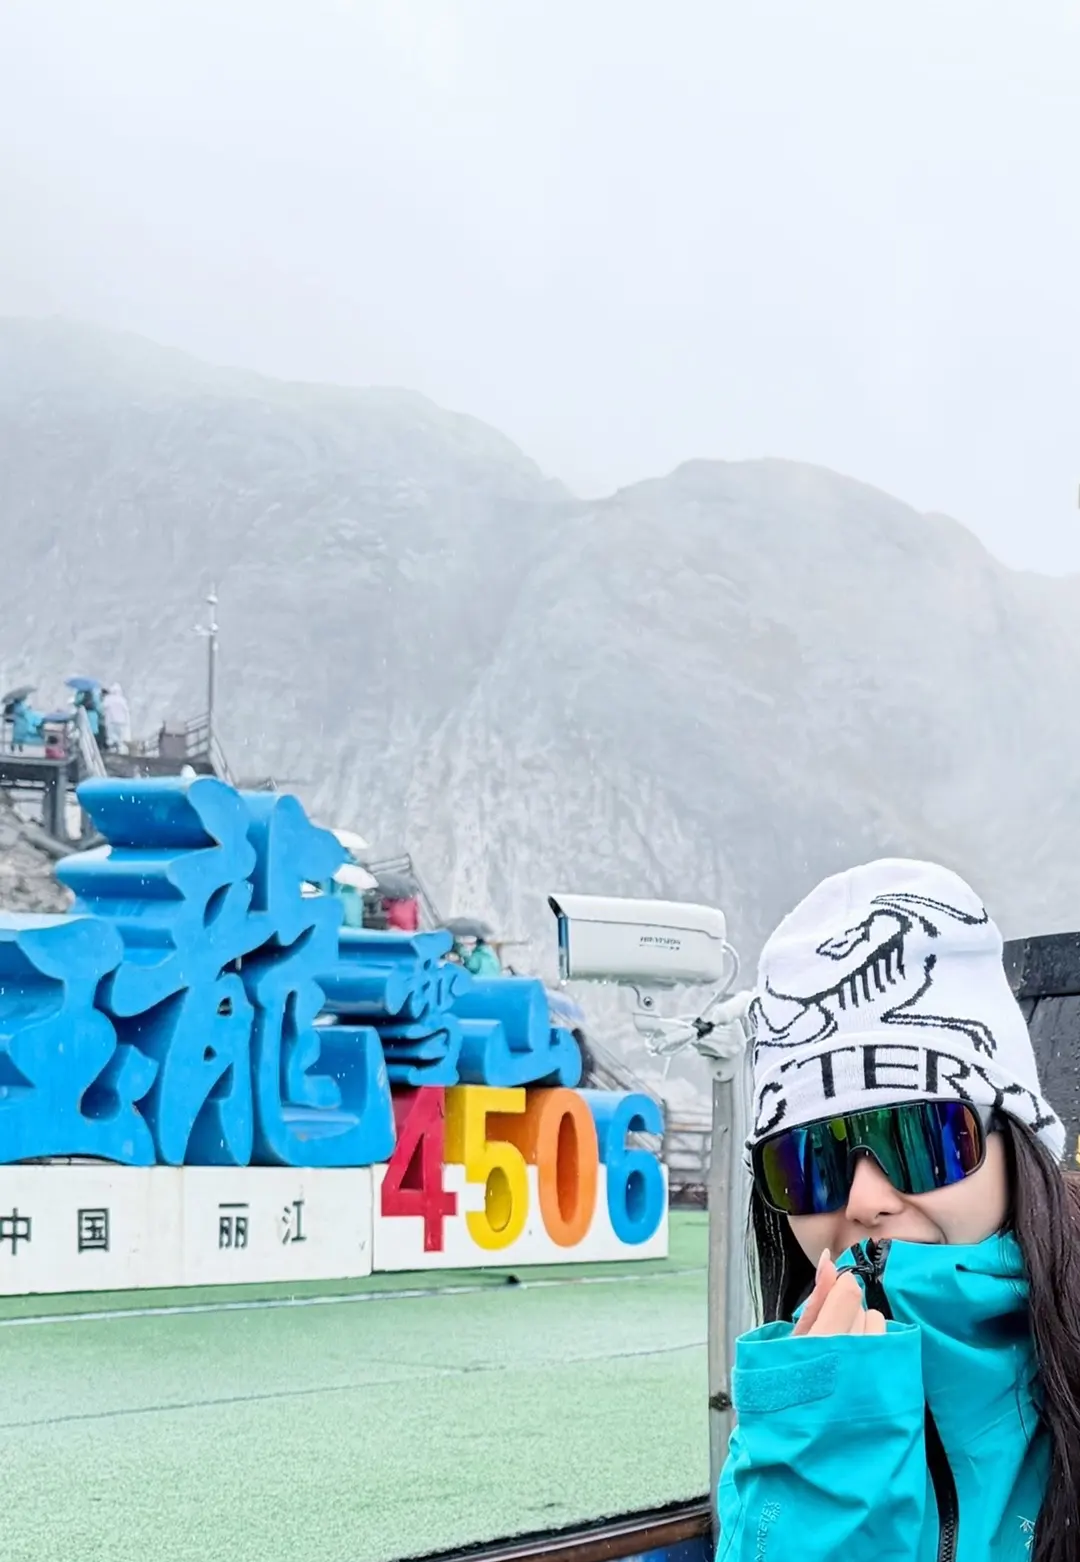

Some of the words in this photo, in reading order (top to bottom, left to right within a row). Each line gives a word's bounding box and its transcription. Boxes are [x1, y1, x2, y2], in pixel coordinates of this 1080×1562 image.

[380, 1085, 667, 1252] 4506
[0, 1208, 109, 1255] 中国
[219, 1200, 307, 1249] 丽江
